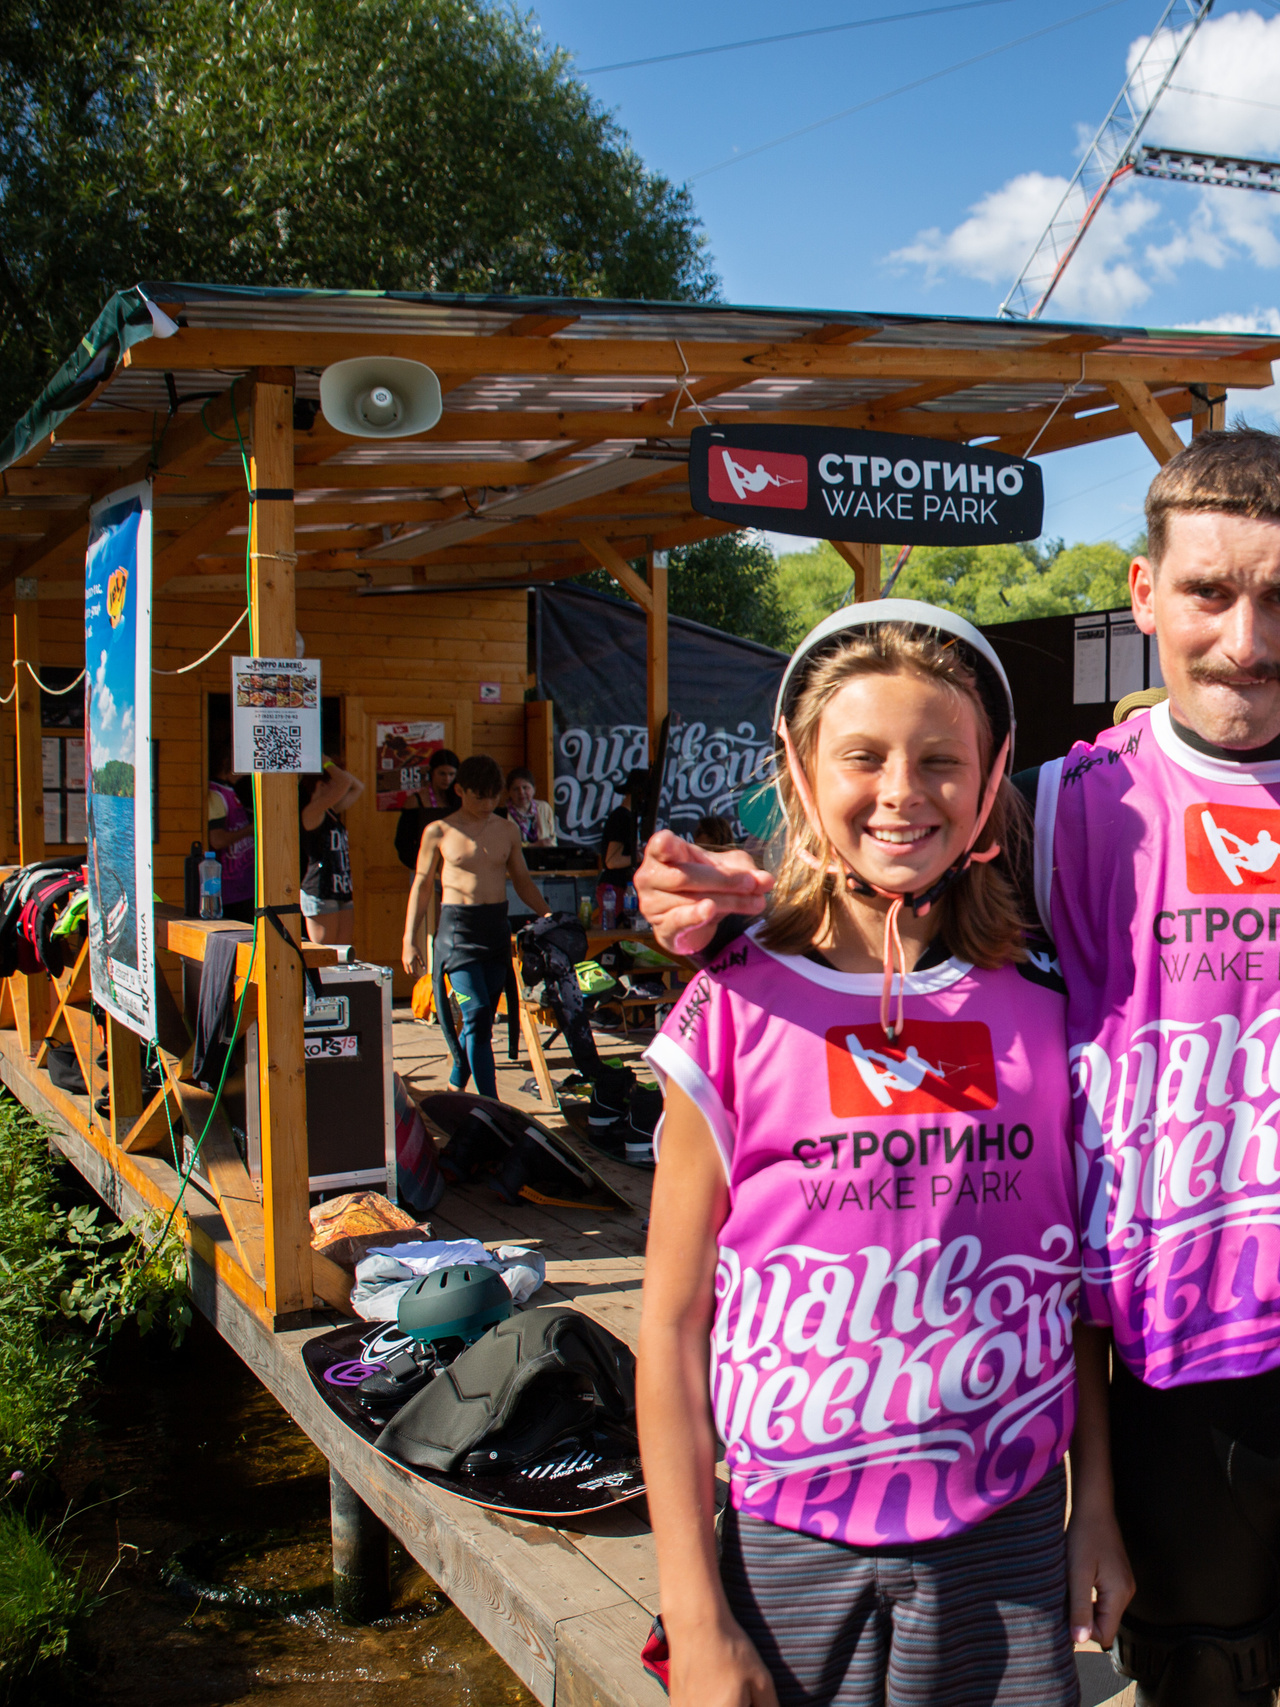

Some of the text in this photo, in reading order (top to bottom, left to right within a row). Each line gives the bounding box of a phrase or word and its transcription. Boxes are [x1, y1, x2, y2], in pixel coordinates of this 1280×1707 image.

[818, 453, 1024, 496] СТРОГИНО
[821, 488, 999, 526] WAKE PARK
[1159, 951, 1264, 984] WAKE
[679, 975, 712, 1043] HARD
[793, 1123, 1034, 1170] СТРОГИНО
[800, 1170, 1022, 1211] WAKE PARK
[576, 1464, 594, 1472] WAY
